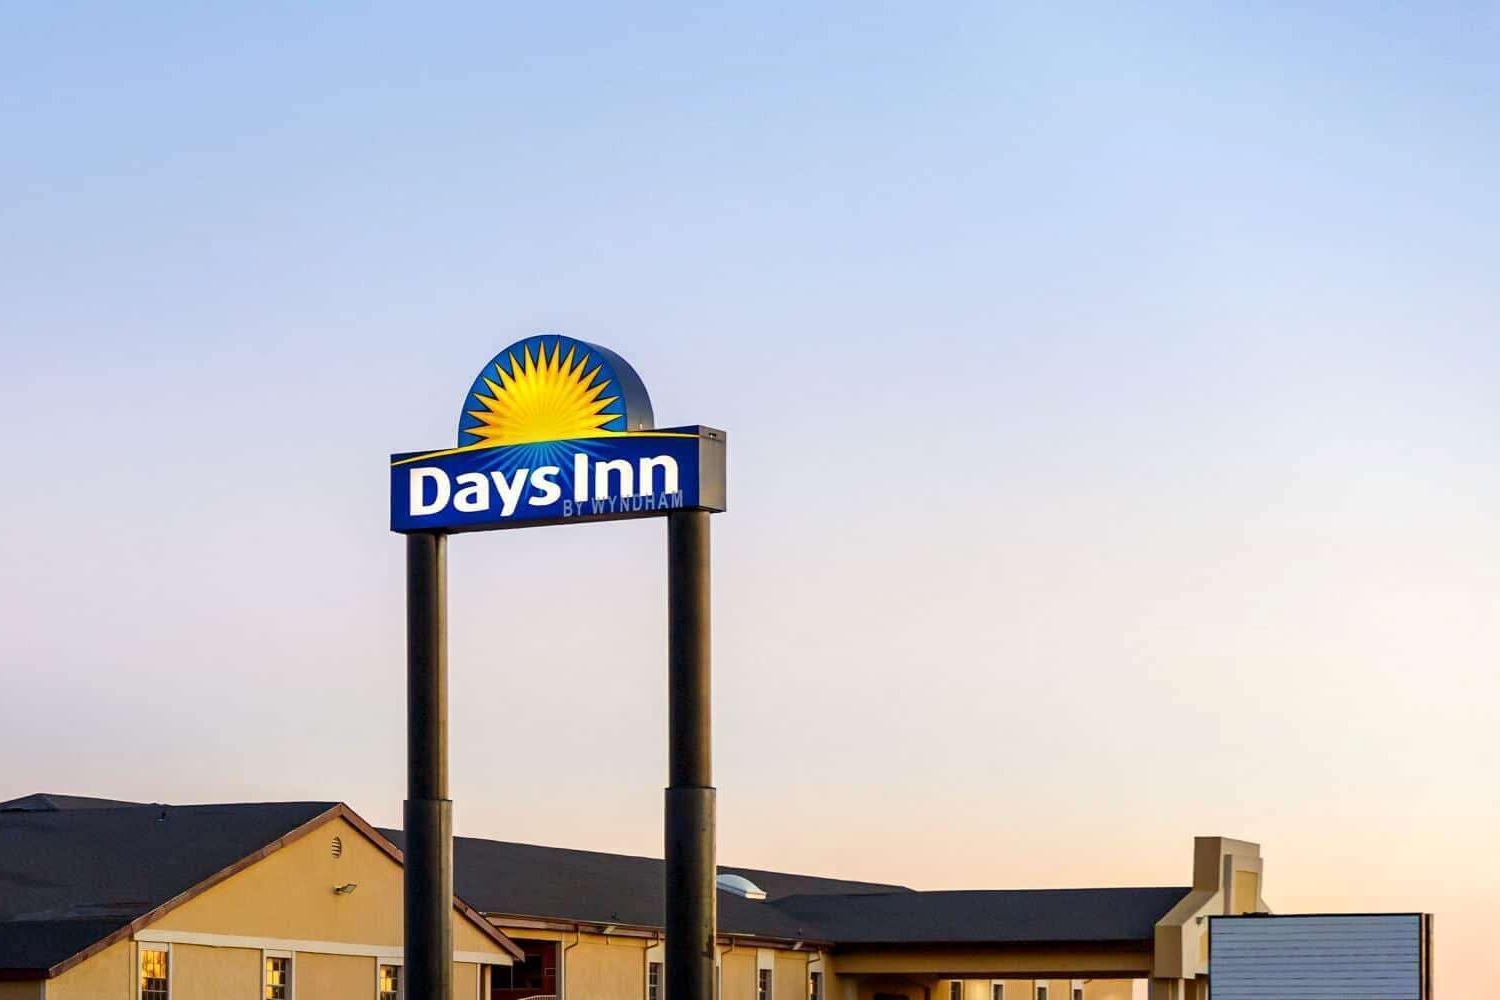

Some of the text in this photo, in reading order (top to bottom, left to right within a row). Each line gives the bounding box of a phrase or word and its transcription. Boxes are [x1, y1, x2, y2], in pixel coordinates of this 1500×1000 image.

[409, 453, 679, 518] Days Inn
[563, 489, 684, 517] BY WYNDHAM
